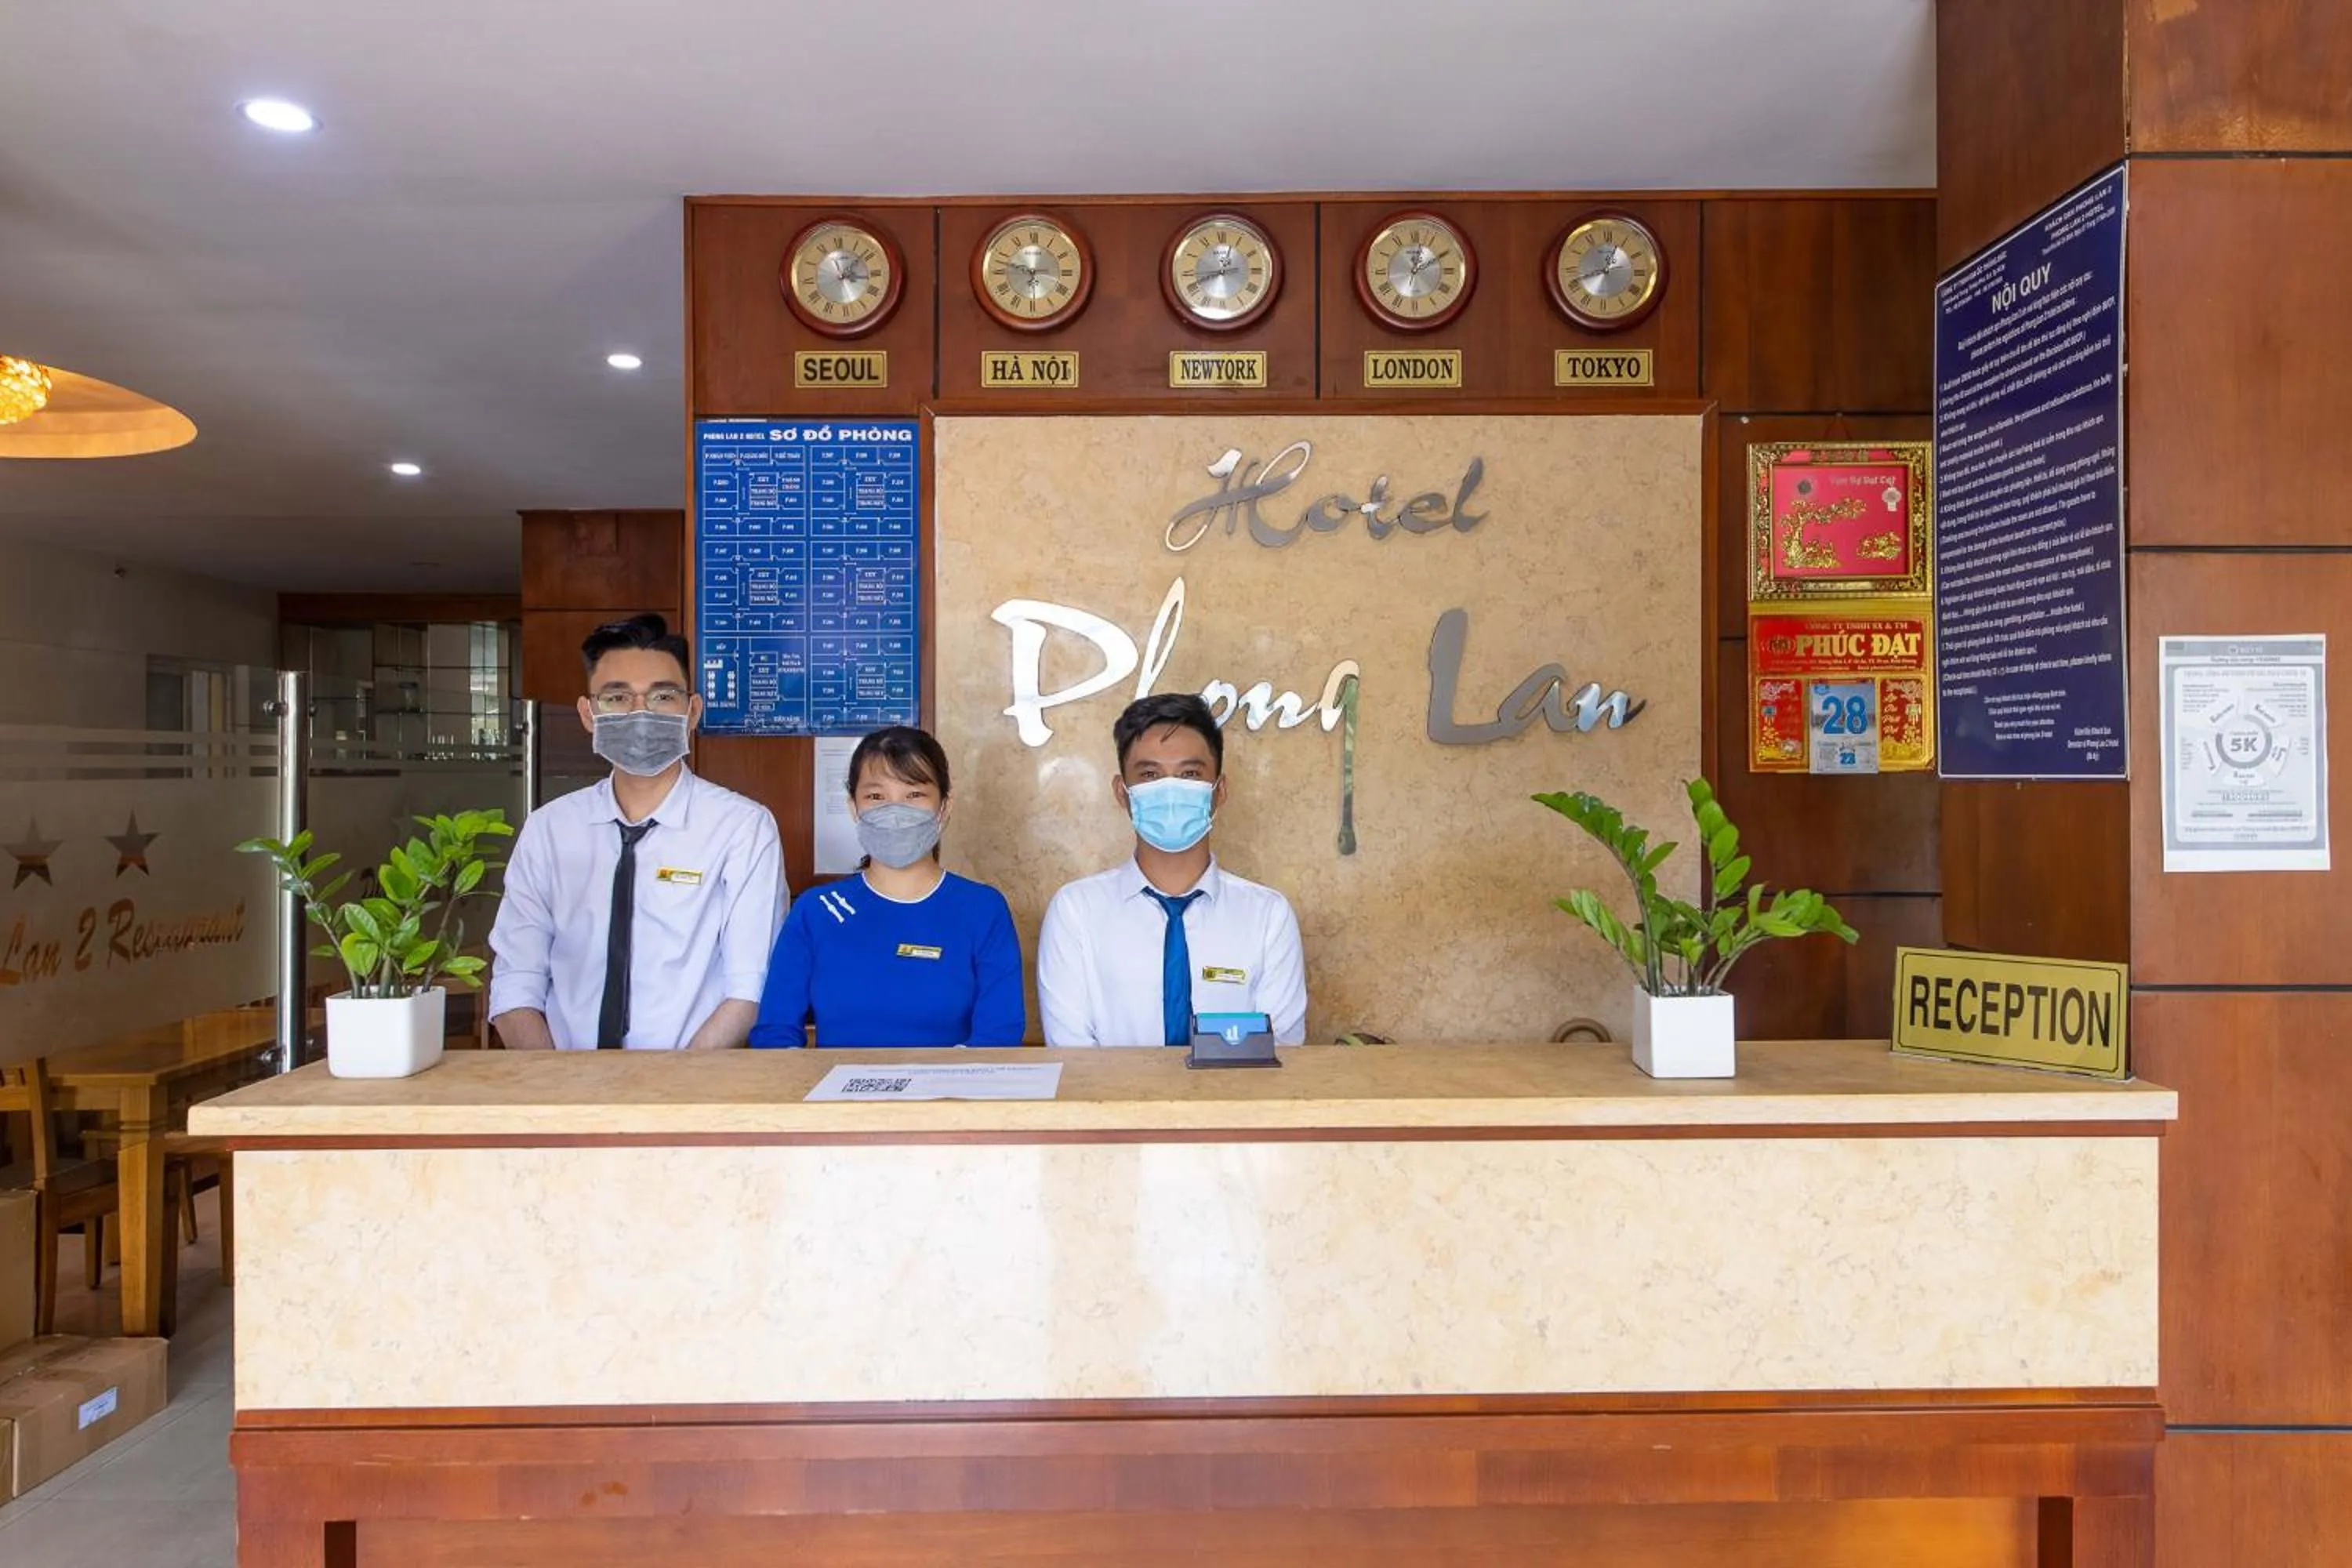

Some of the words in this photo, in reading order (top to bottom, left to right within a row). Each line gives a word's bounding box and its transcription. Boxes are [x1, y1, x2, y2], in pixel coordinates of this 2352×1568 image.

[1991, 283, 2016, 314] NỘI
[2020, 262, 2052, 295] QUY
[804, 358, 879, 381] SEOUL
[991, 356, 1023, 380] HÀ
[1031, 357, 1069, 386] NỘI
[1180, 359, 1257, 379] NEWYORK
[1372, 359, 1454, 379] LONDON
[1567, 358, 1641, 378] TOKYO
[769, 427, 797, 441] SƠ
[1166, 440, 1488, 551] Hotel
[1795, 630, 1866, 656] PHÚC
[1871, 633, 1921, 658] ĐẠT
[1427, 608, 1646, 746] Lan
[1822, 695, 1867, 735] 28
[2230, 737, 2258, 753] 5K
[74, 907, 96, 972] 2
[1908, 975, 2112, 1048] RECEPTION
